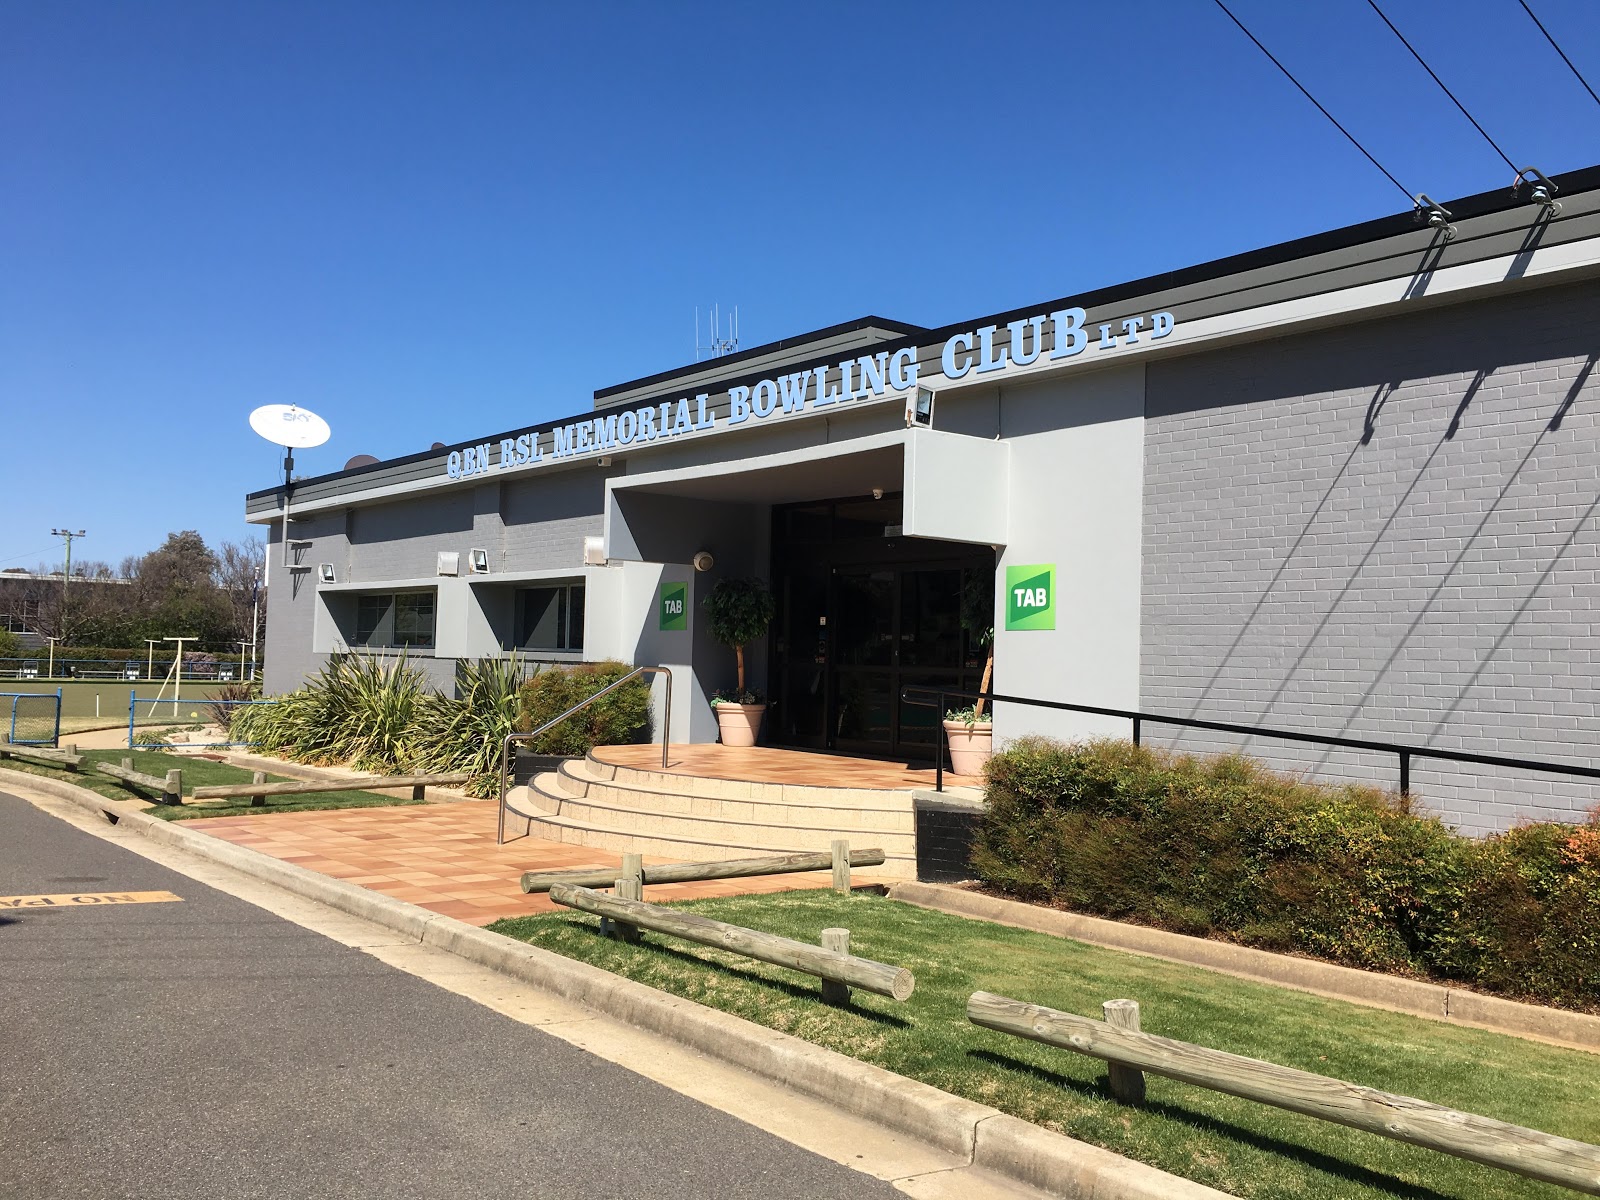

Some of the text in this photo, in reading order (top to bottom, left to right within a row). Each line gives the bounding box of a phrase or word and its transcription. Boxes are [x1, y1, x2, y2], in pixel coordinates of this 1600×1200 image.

[447, 306, 1175, 479] QBN RSL MEMORIAL BOWLING CLUB LTD
[1013, 588, 1047, 607] TAB
[664, 599, 683, 614] TAB
[72, 895, 137, 904] NO
